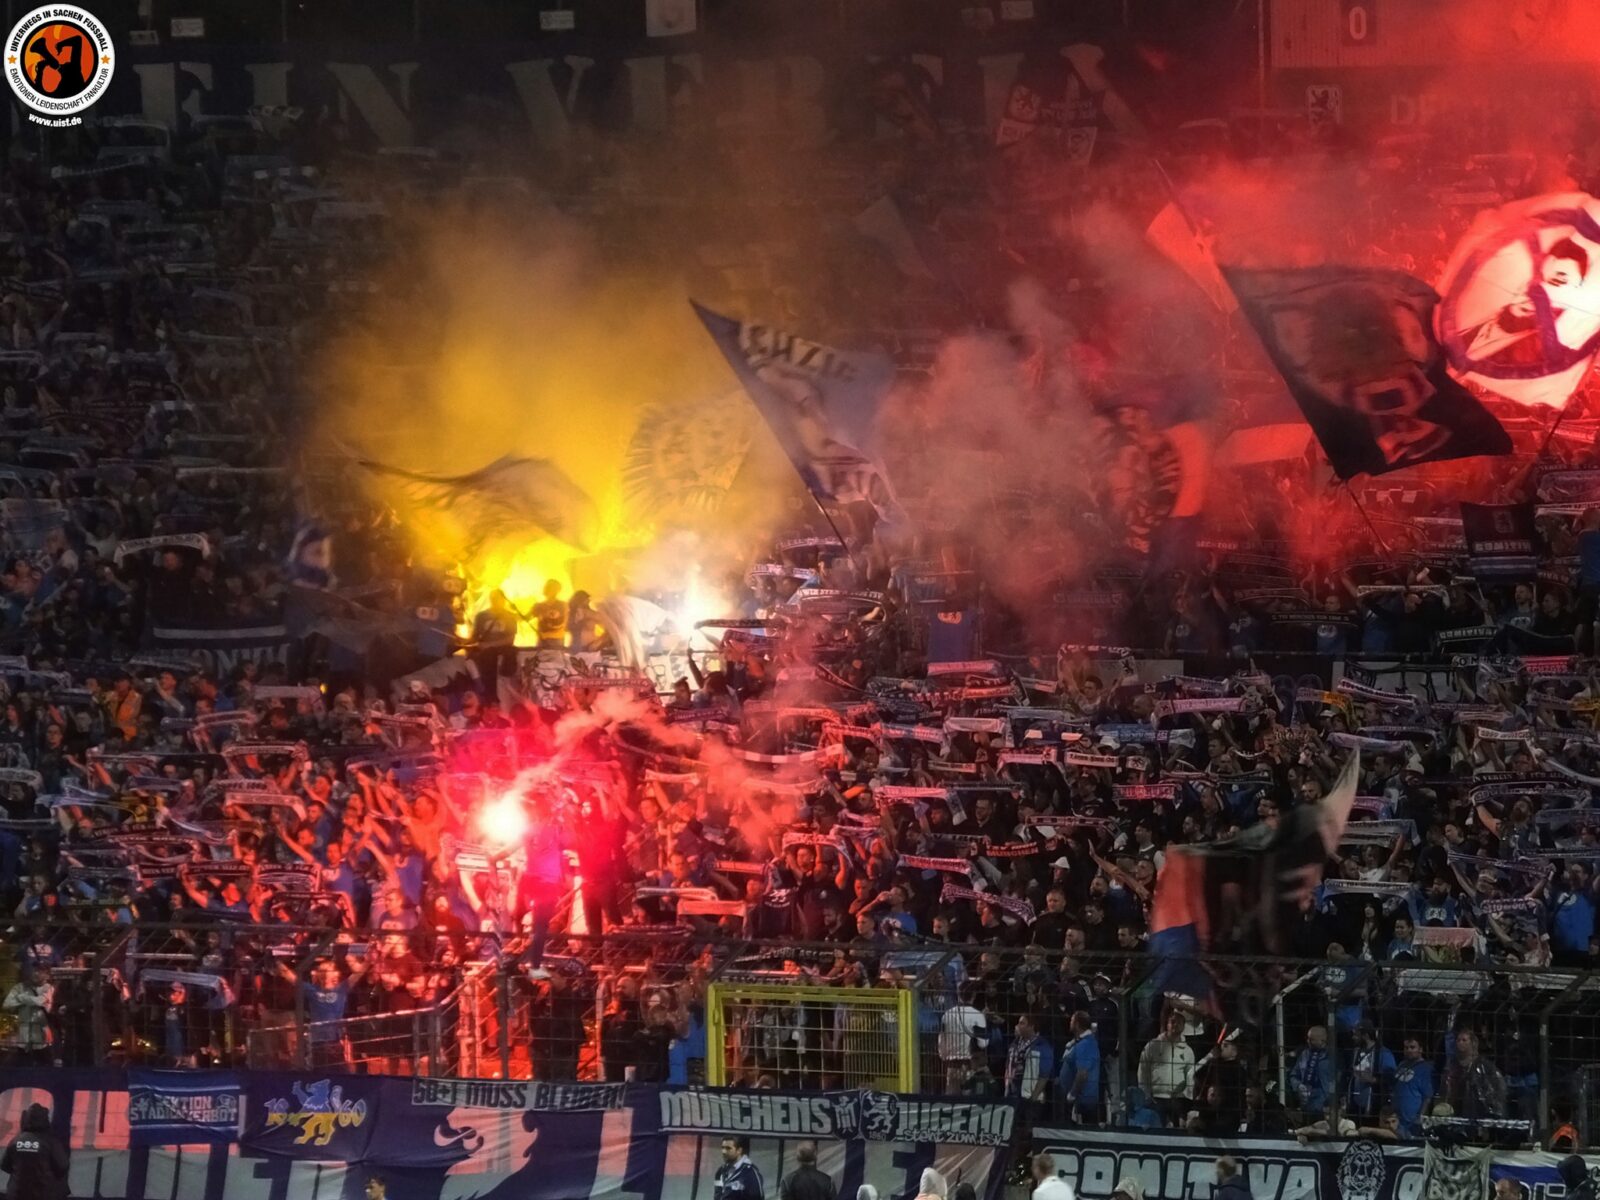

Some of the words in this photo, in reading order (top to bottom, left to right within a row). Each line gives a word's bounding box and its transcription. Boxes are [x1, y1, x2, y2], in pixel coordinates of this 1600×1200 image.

[1348, 6, 1367, 40] 0
[414, 1080, 457, 1102] 50+1
[465, 1082, 529, 1108] MUSS
[534, 1083, 624, 1111] BLEIBEN!
[659, 1085, 832, 1134] MÜNCHENS
[896, 1102, 1014, 1141] JUGEND
[1043, 1149, 1320, 1200] COMITVA
